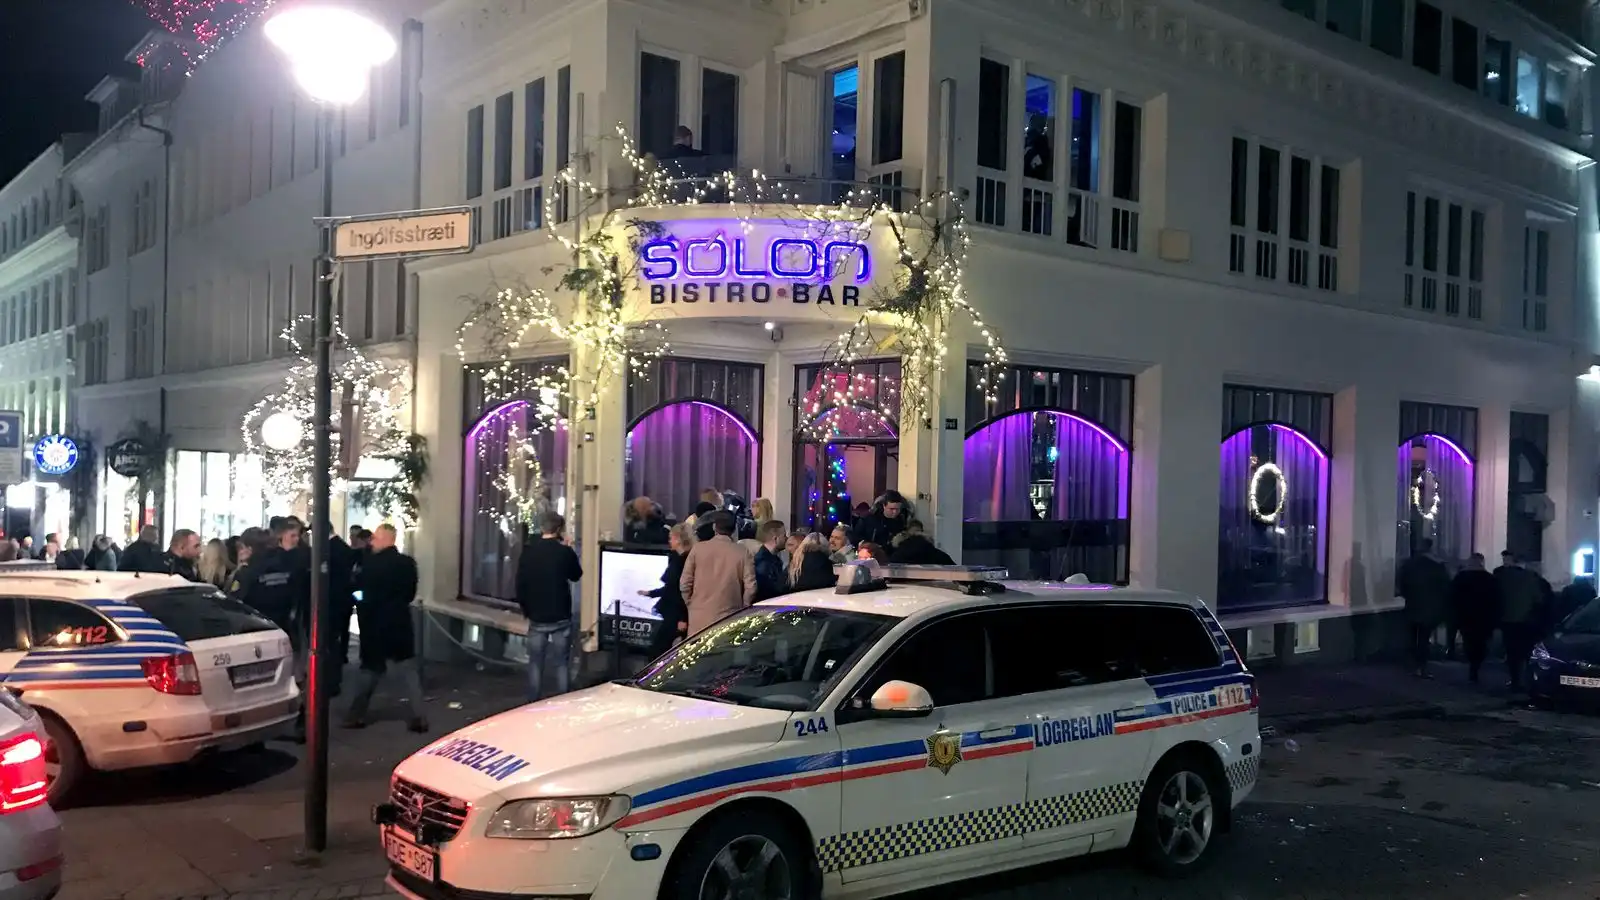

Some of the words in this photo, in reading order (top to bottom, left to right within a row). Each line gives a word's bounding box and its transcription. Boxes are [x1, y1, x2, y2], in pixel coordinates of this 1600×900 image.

[349, 221, 456, 249] Ingólfsstræti
[650, 282, 771, 304] BISTRO
[792, 283, 860, 306] BAR
[73, 625, 108, 644] 112
[1174, 693, 1208, 715] POLICE
[1225, 687, 1245, 705] 112
[794, 716, 829, 737] 244
[1034, 712, 1114, 748] LÖGREGLAN
[426, 737, 531, 781] GREGLAN
